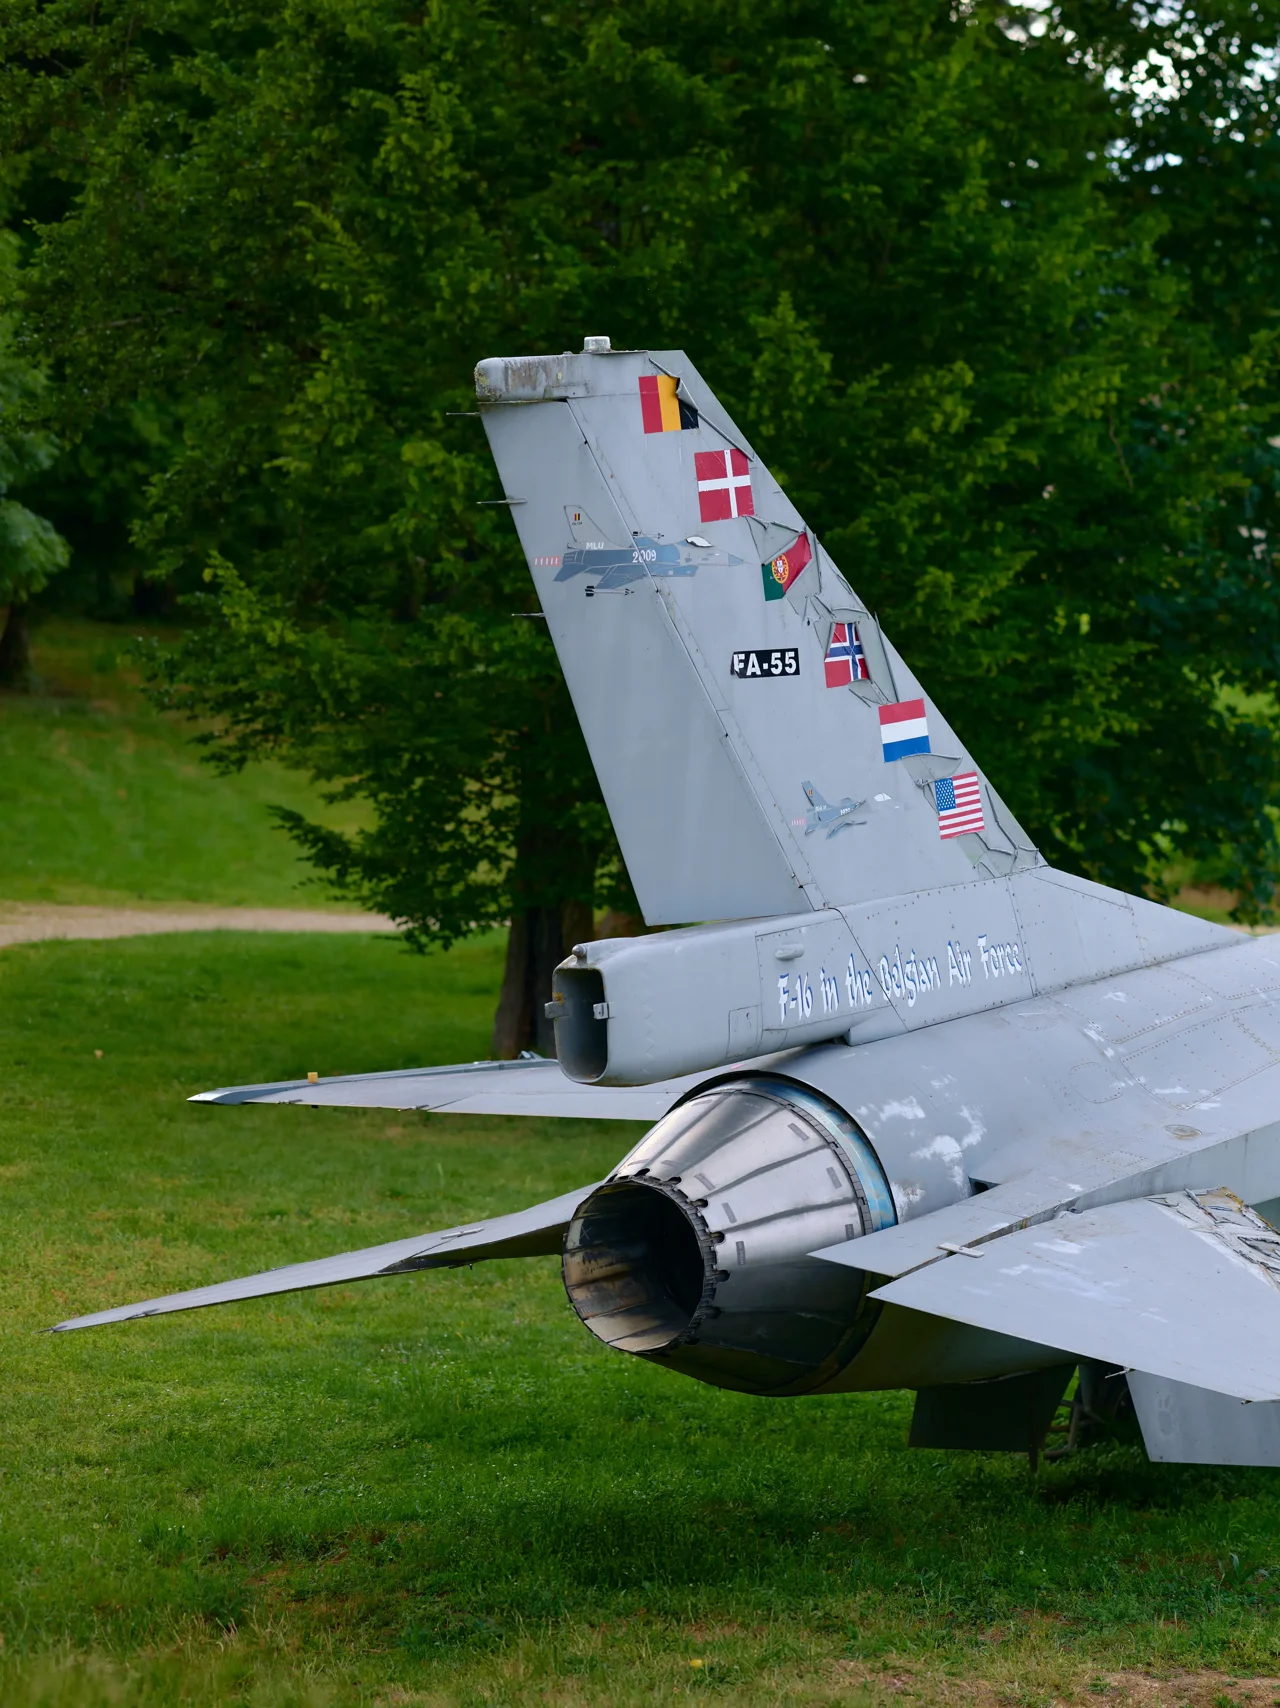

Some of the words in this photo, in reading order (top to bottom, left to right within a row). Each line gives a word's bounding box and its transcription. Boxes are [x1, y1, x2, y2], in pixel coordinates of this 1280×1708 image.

[586, 541, 605, 550] MLU
[632, 549, 657, 563] 2009
[733, 651, 797, 676] FA-55
[777, 973, 814, 1024] F-16
[820, 967, 840, 1014] in
[845, 953, 872, 1008] the
[877, 944, 942, 1008] Belgian
[947, 939, 972, 988] Air
[977, 934, 1022, 980] Force
